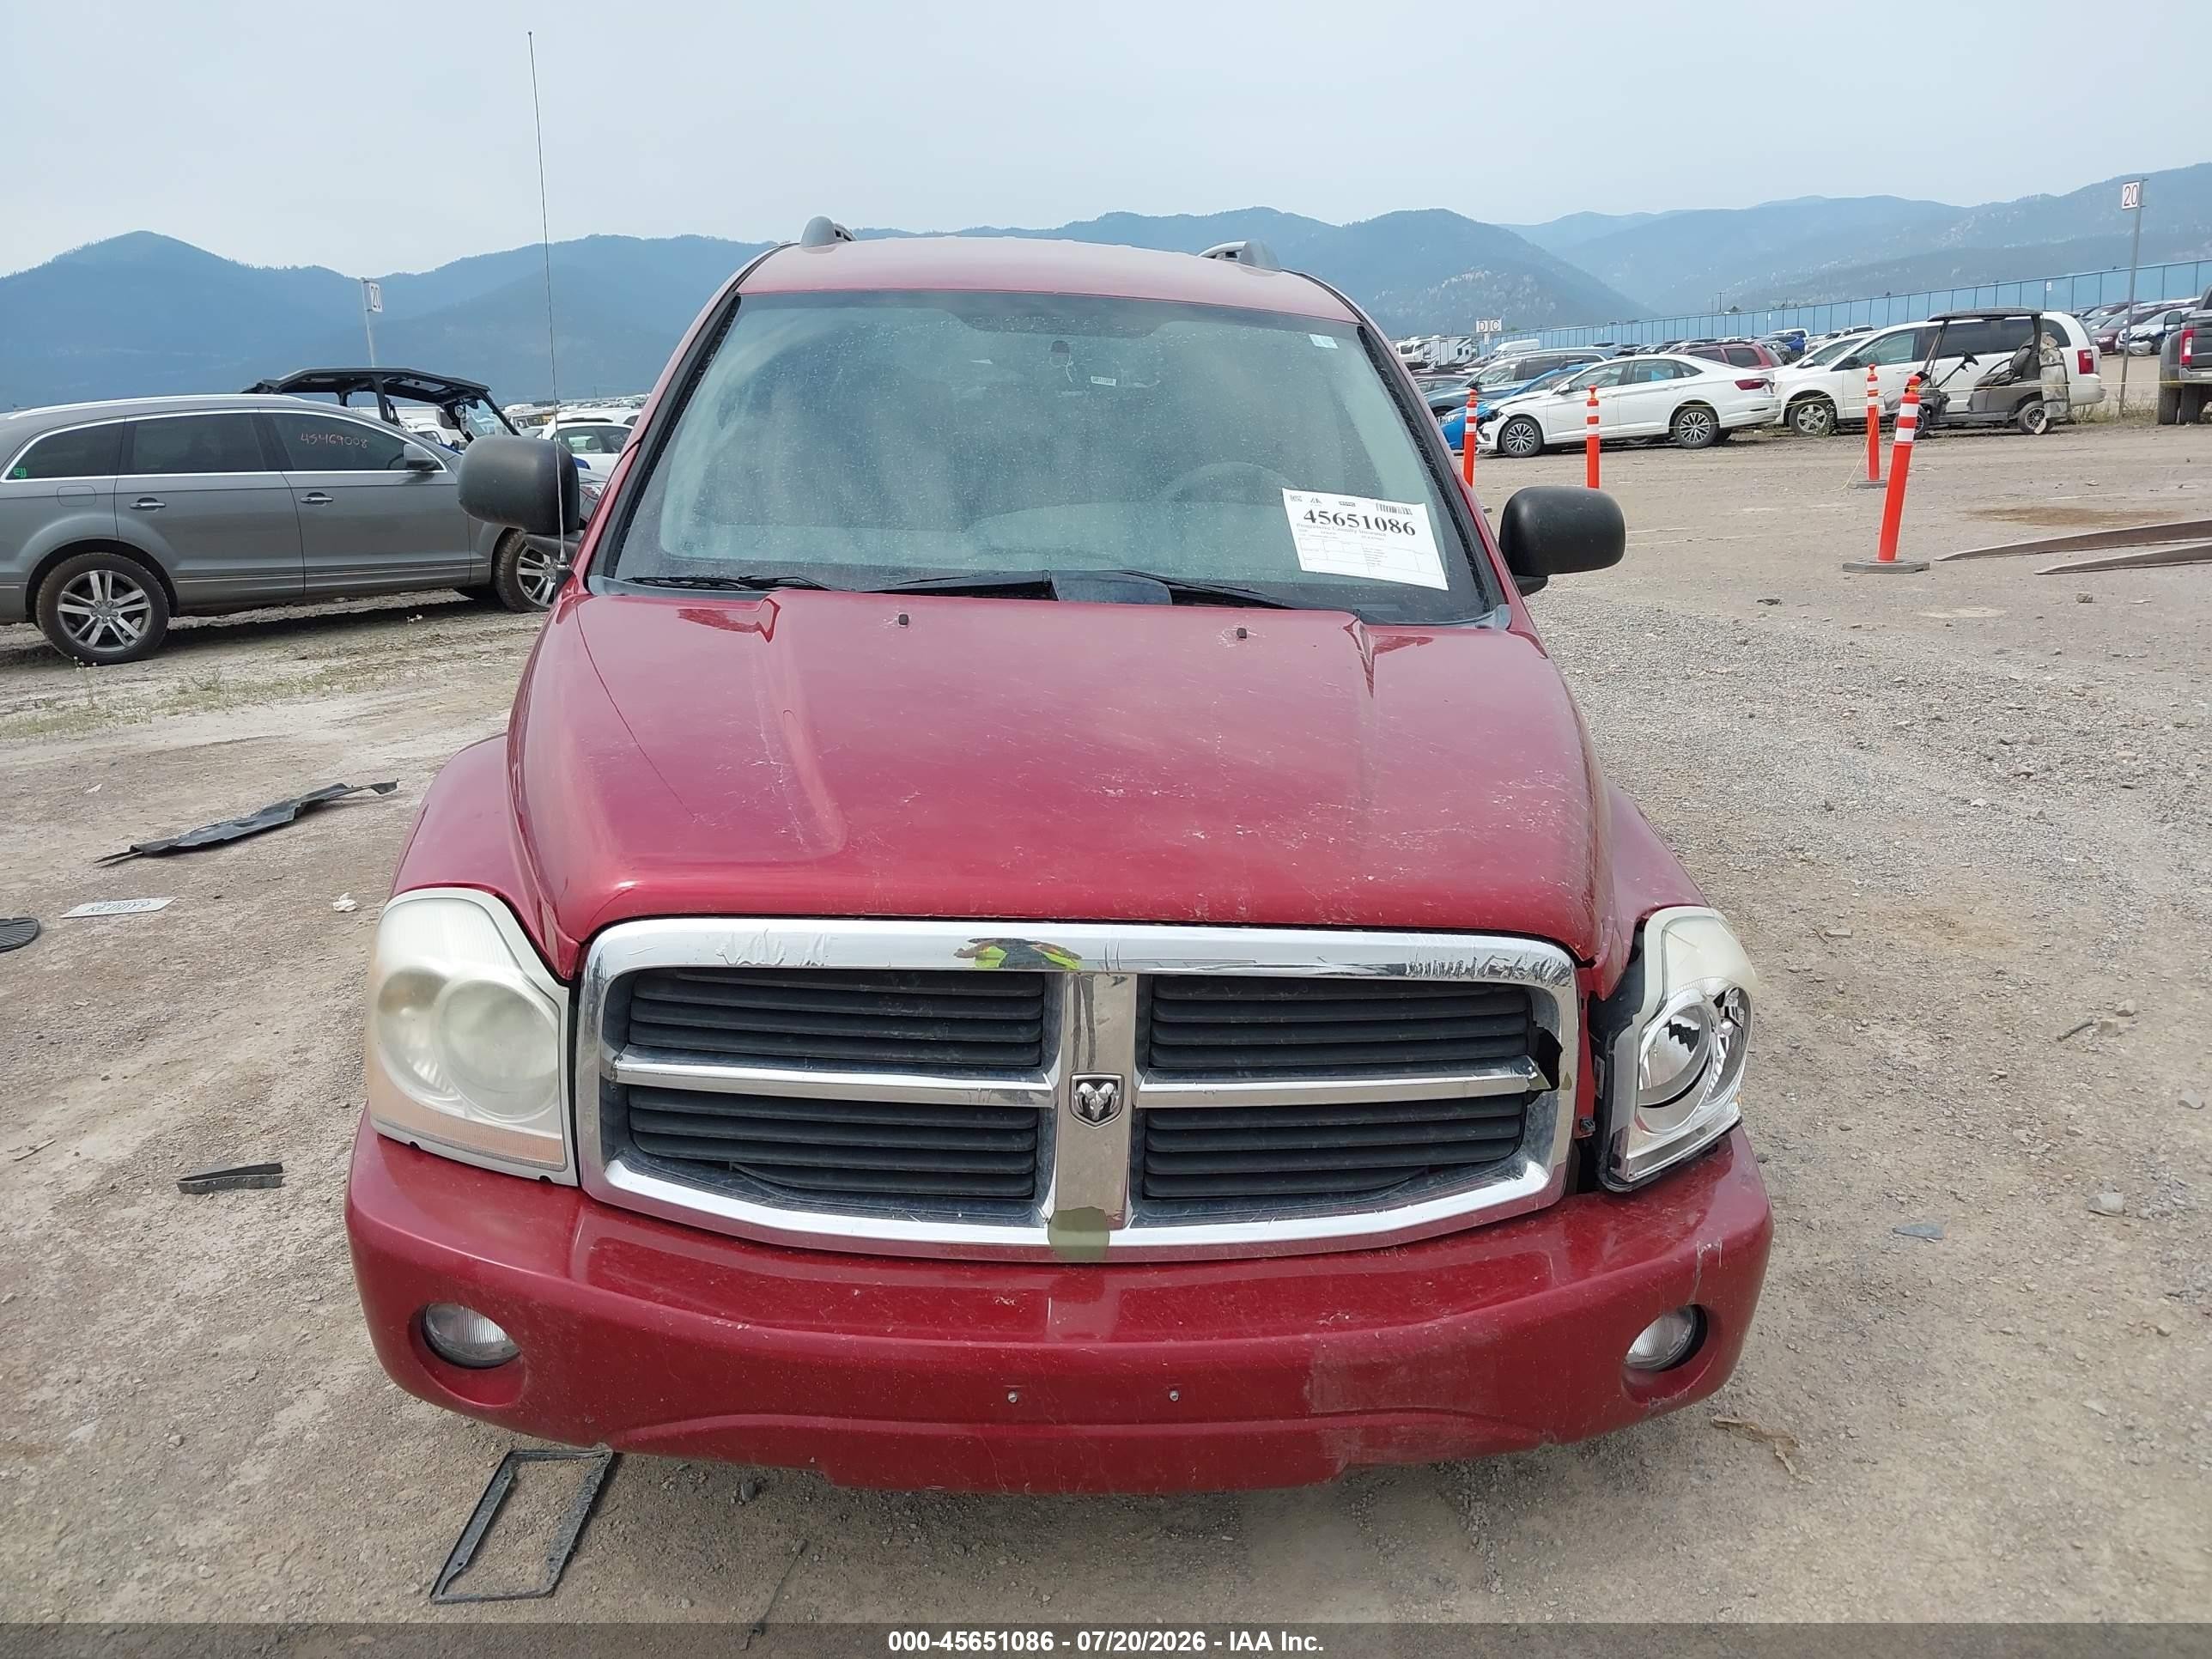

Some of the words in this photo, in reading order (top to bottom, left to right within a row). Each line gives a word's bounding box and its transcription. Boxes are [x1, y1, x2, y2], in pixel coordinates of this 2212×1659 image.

[2123, 184, 2138, 207] 20
[1479, 321, 1486, 331] D
[1492, 320, 1499, 331] C
[301, 432, 368, 449] 45469008
[1304, 507, 1416, 538] 45651086
